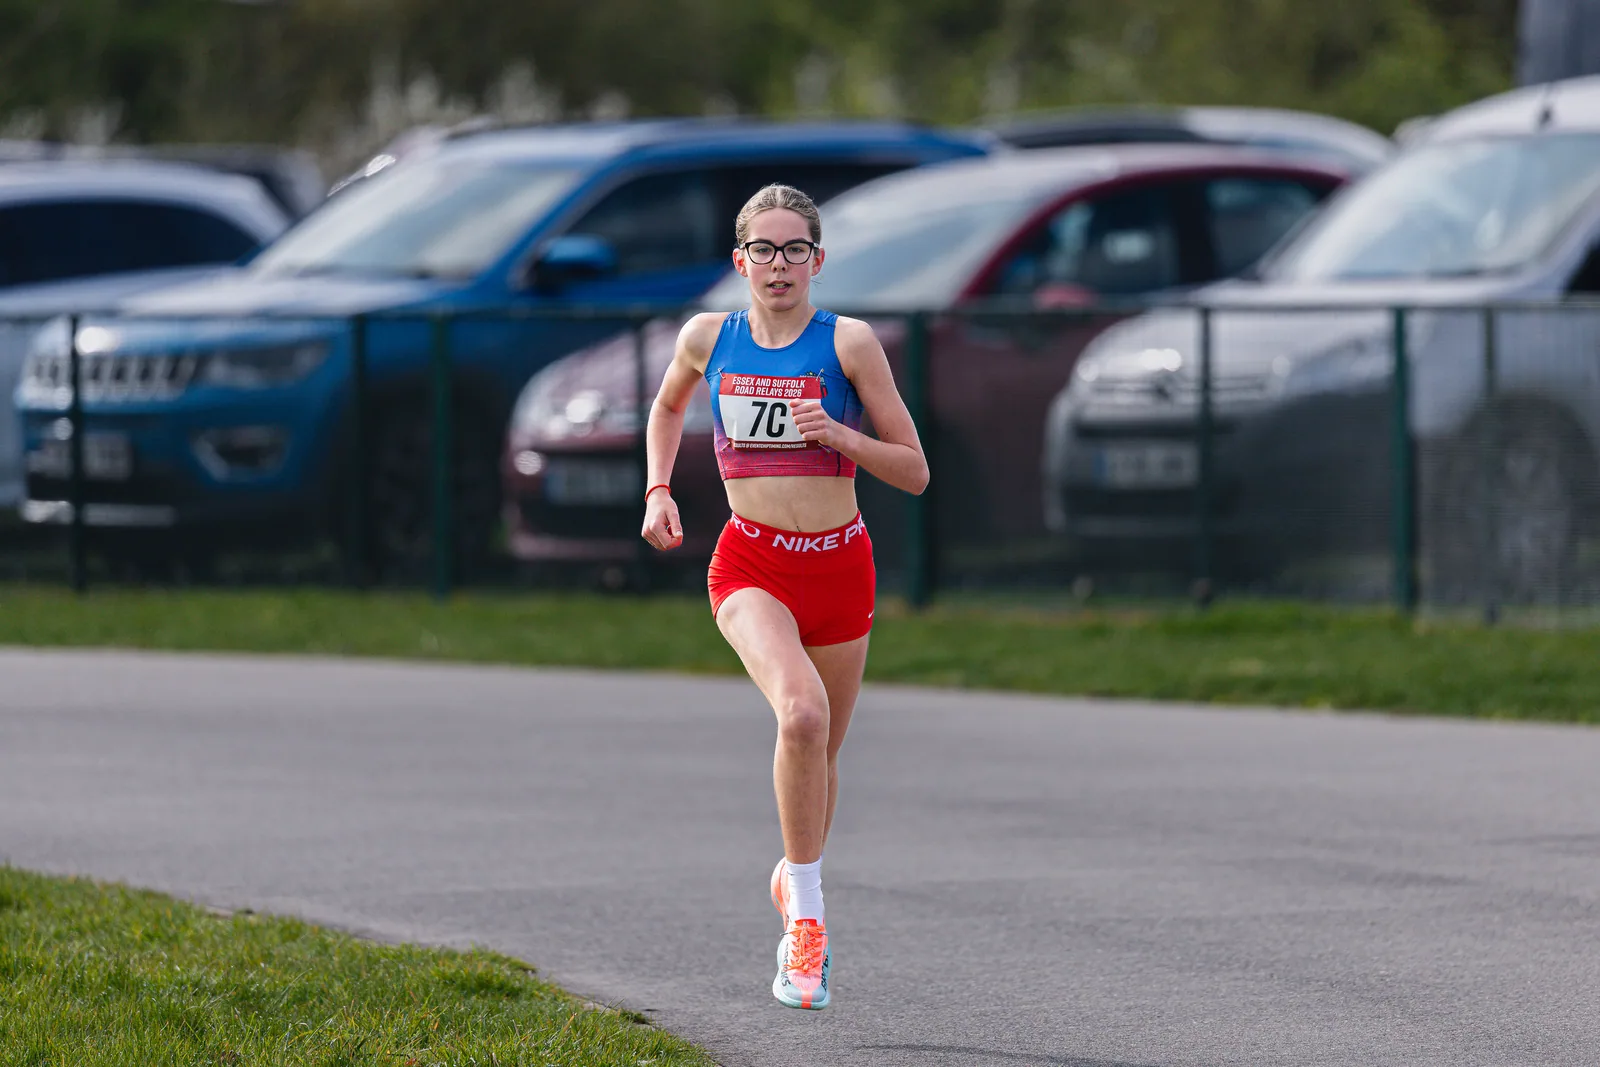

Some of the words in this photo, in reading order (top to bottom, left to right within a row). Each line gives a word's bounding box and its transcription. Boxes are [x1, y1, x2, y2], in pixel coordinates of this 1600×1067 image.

[732, 376, 755, 386] ESSEX
[755, 378, 771, 387] AND
[772, 379, 806, 388] SUFFOLK
[734, 386, 755, 395] ROAD
[755, 387, 783, 397] RELAYS
[784, 388, 802, 397] 2026
[749, 400, 787, 438] 7C
[730, 512, 760, 538] RO
[772, 532, 840, 552] NIKE
[845, 513, 865, 544] PR
